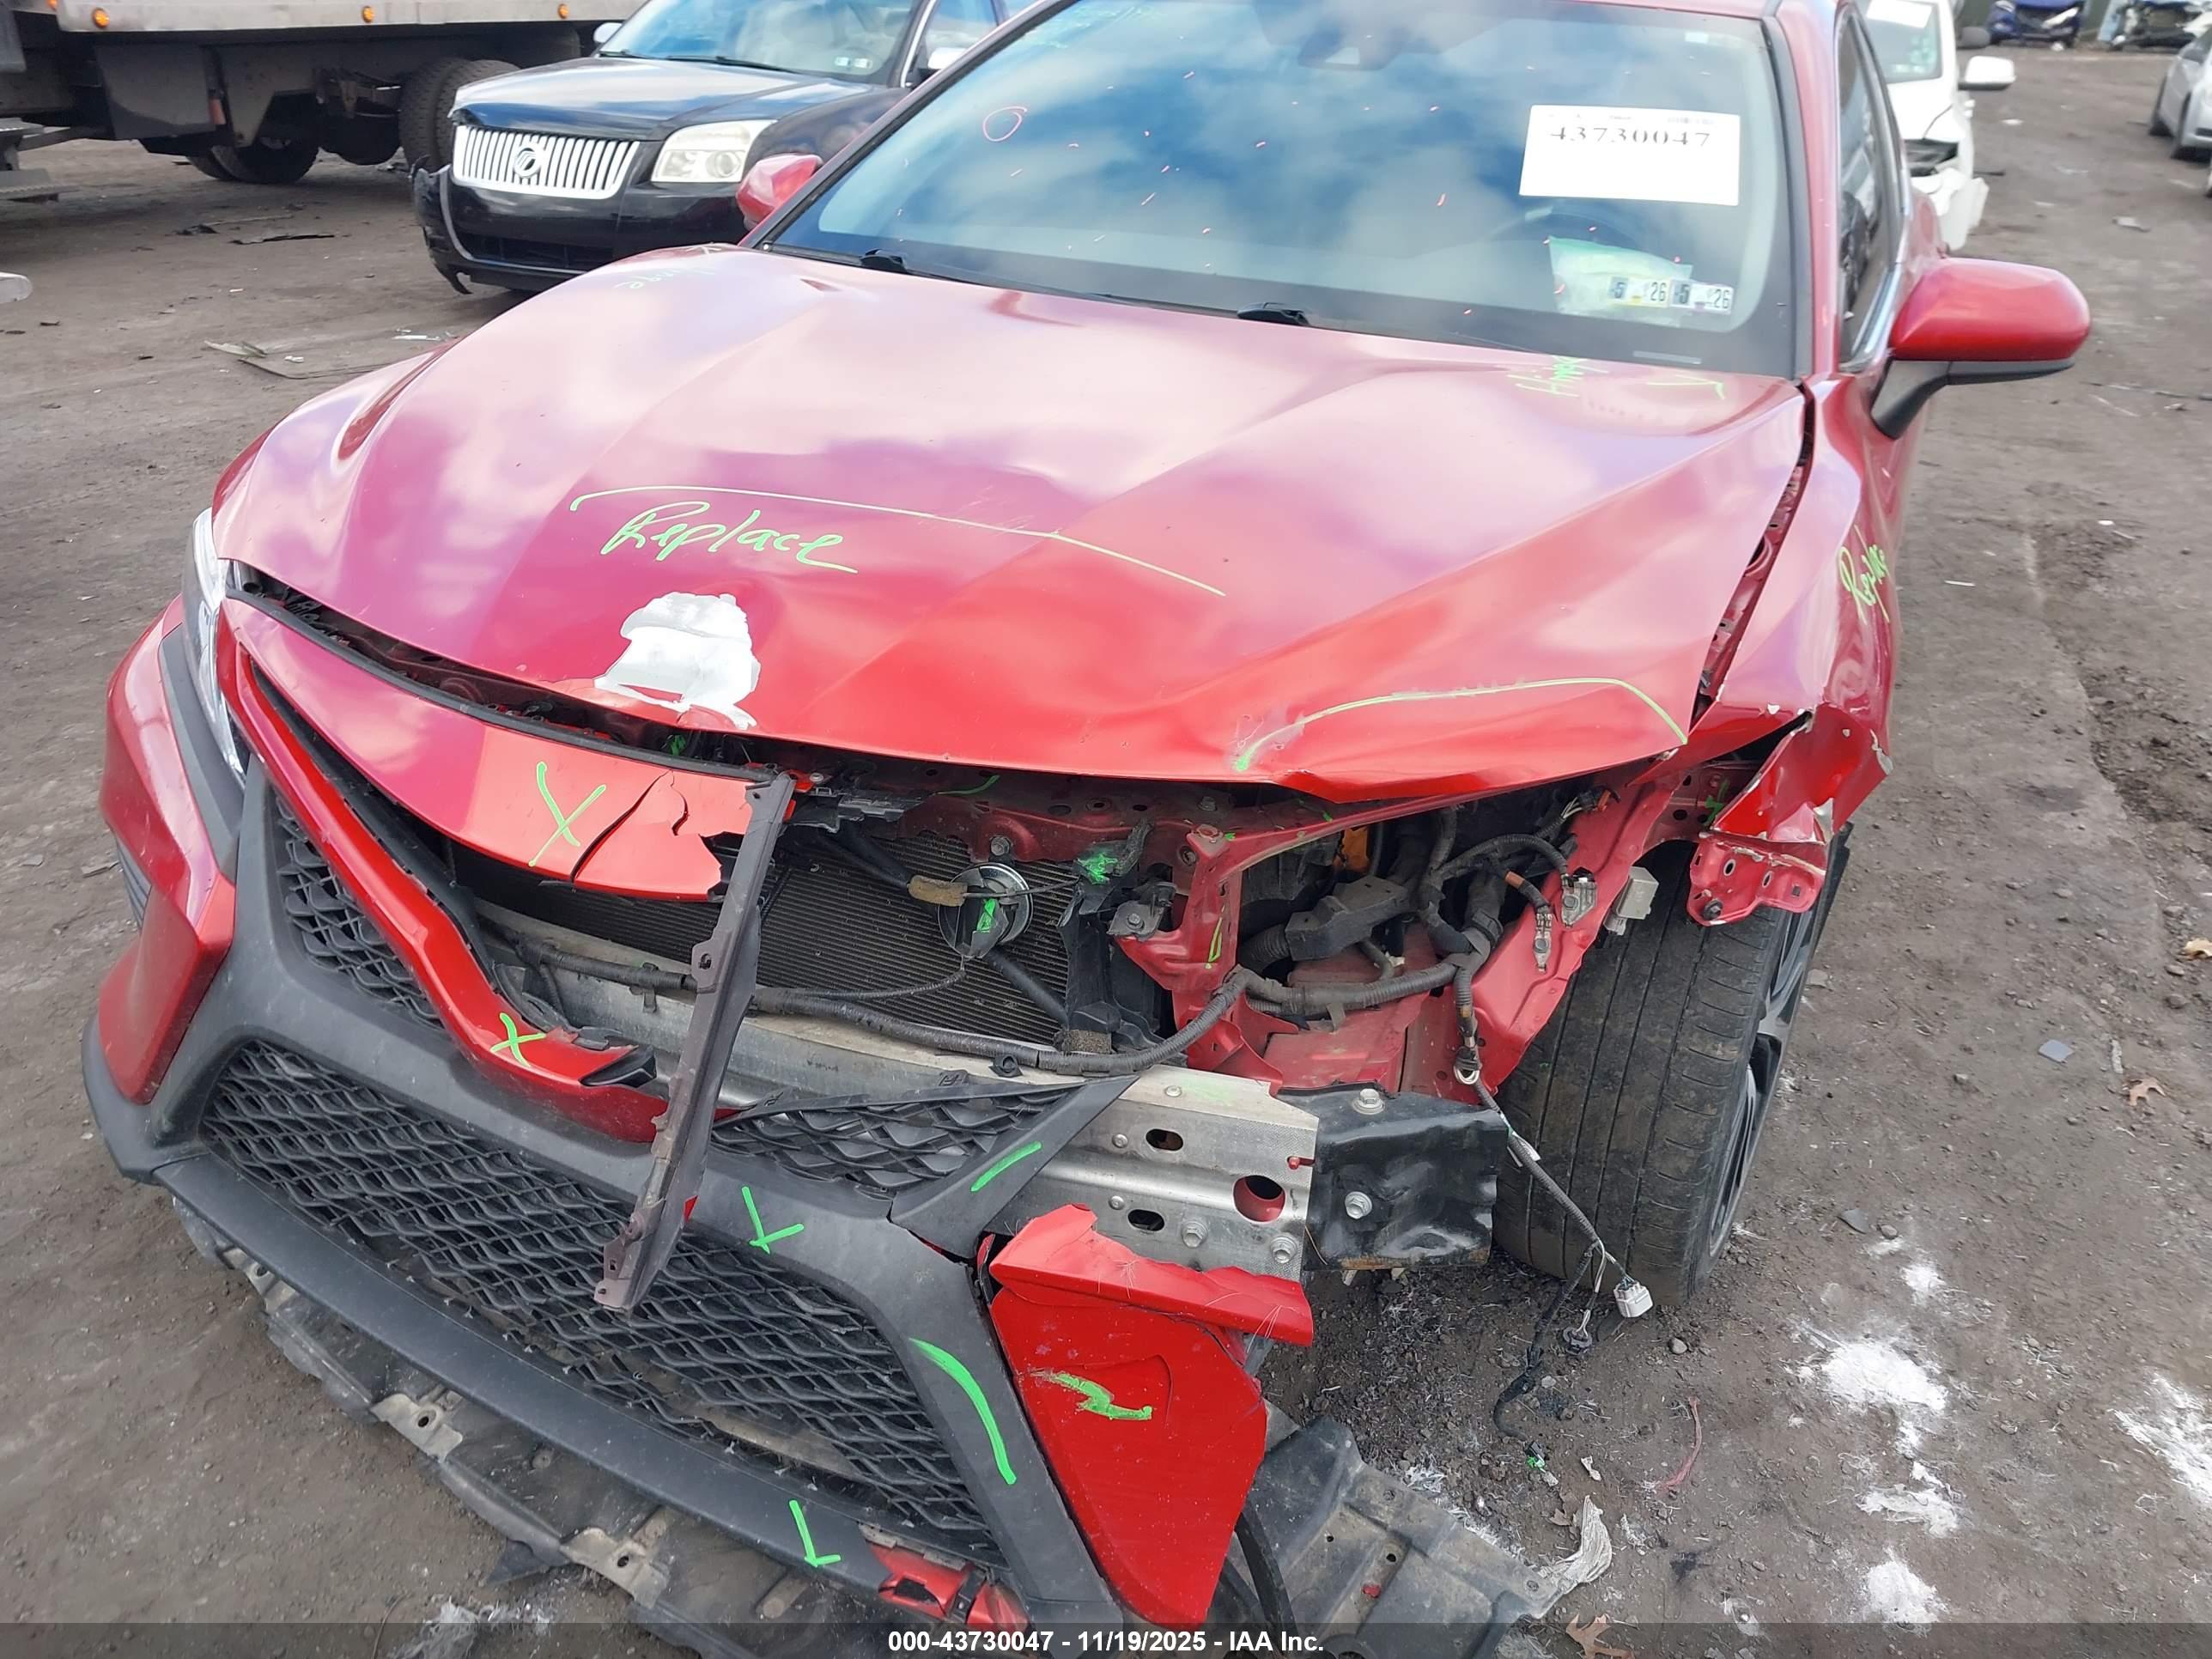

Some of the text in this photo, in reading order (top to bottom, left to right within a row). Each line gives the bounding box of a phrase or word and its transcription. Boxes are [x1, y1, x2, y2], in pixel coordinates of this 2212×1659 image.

[1549, 126, 1711, 147] 43730047
[1650, 281, 1668, 301] 26
[1713, 289, 1730, 309] 26
[601, 501, 858, 574] Replace
